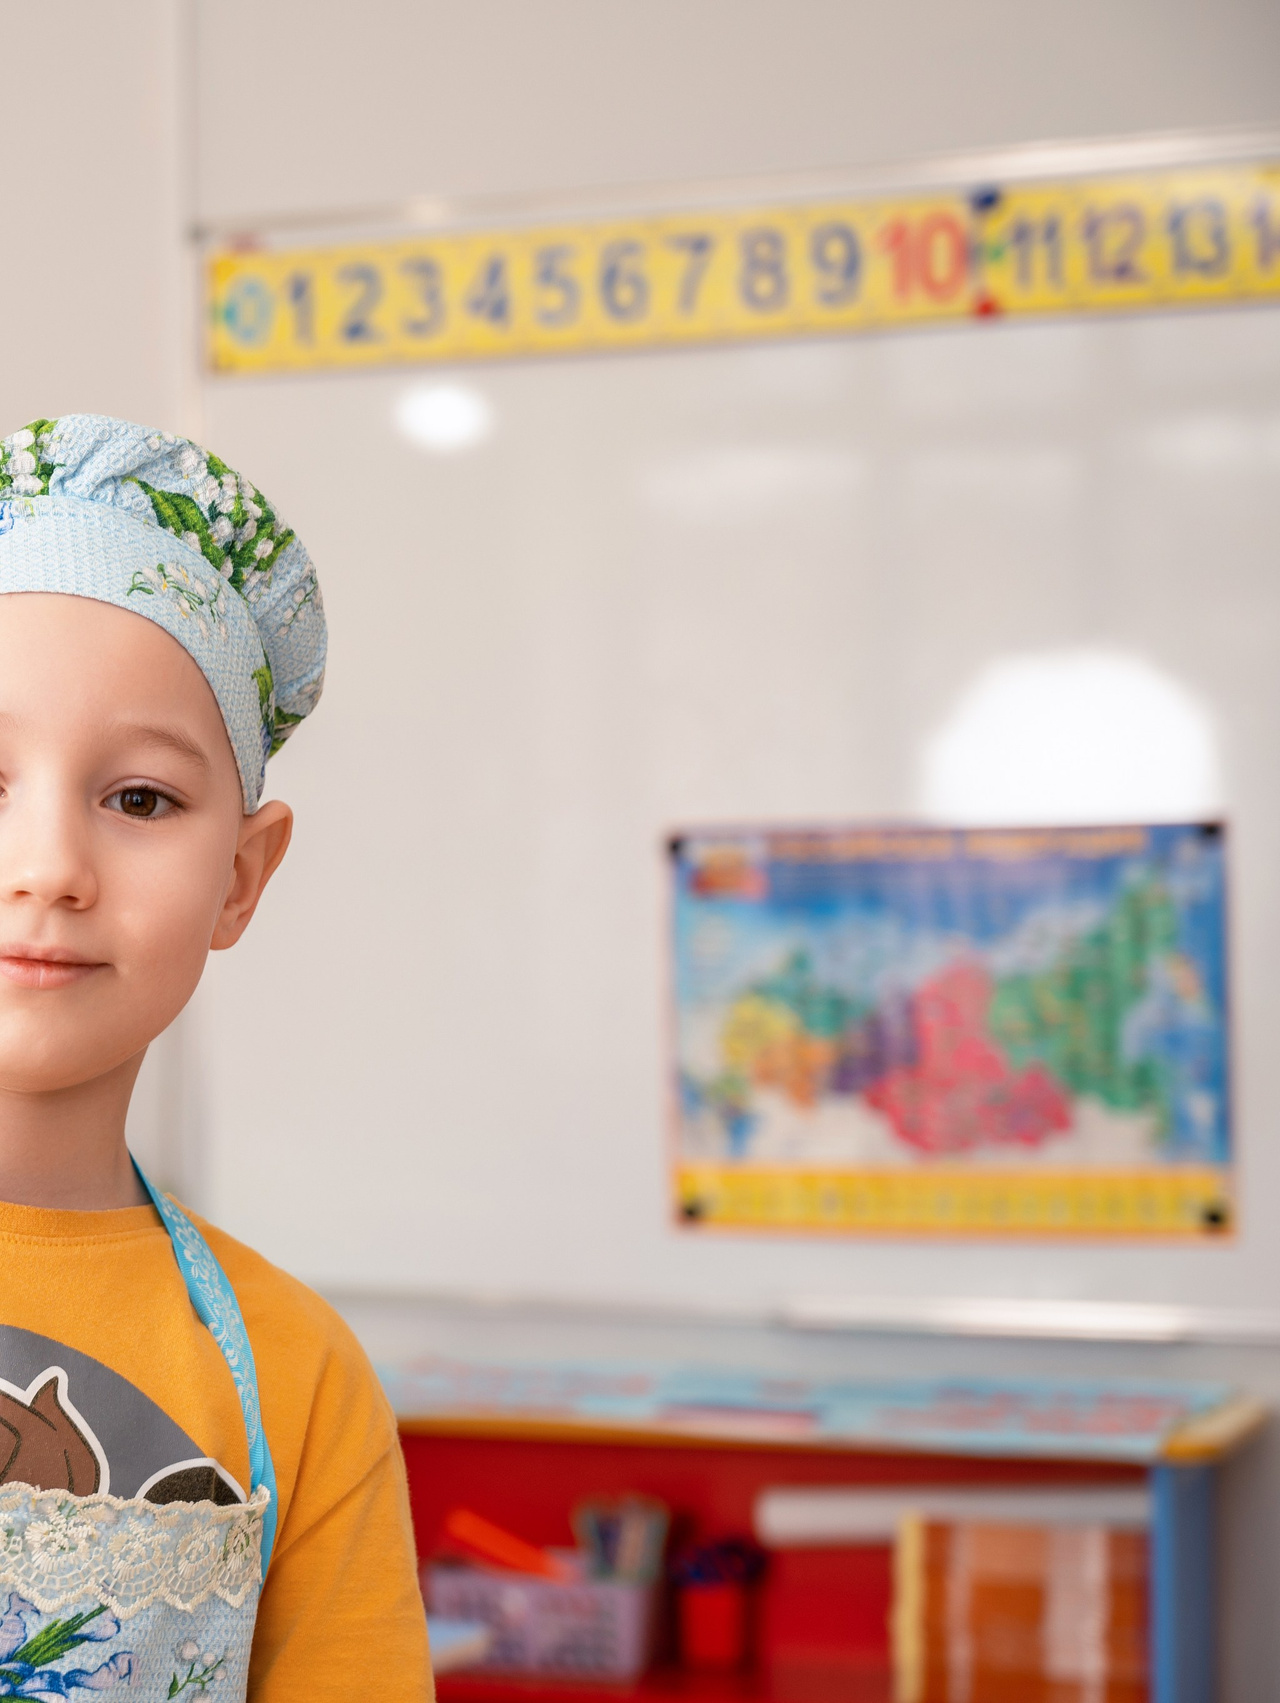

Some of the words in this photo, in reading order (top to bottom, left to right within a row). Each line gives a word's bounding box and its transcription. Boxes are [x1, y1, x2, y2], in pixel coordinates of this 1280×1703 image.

[288, 271, 317, 346] 1
[334, 262, 384, 344] 2
[398, 257, 447, 340] 3
[465, 253, 513, 333] 4
[531, 245, 582, 329] 5
[598, 240, 650, 325] 6
[663, 234, 714, 319] 7
[738, 226, 788, 313] 8
[811, 222, 862, 308] 9
[876, 211, 970, 306] 10
[1011, 215, 1065, 296] 11
[1083, 206, 1148, 286] 12
[1251, 188, 1280, 273] 1
